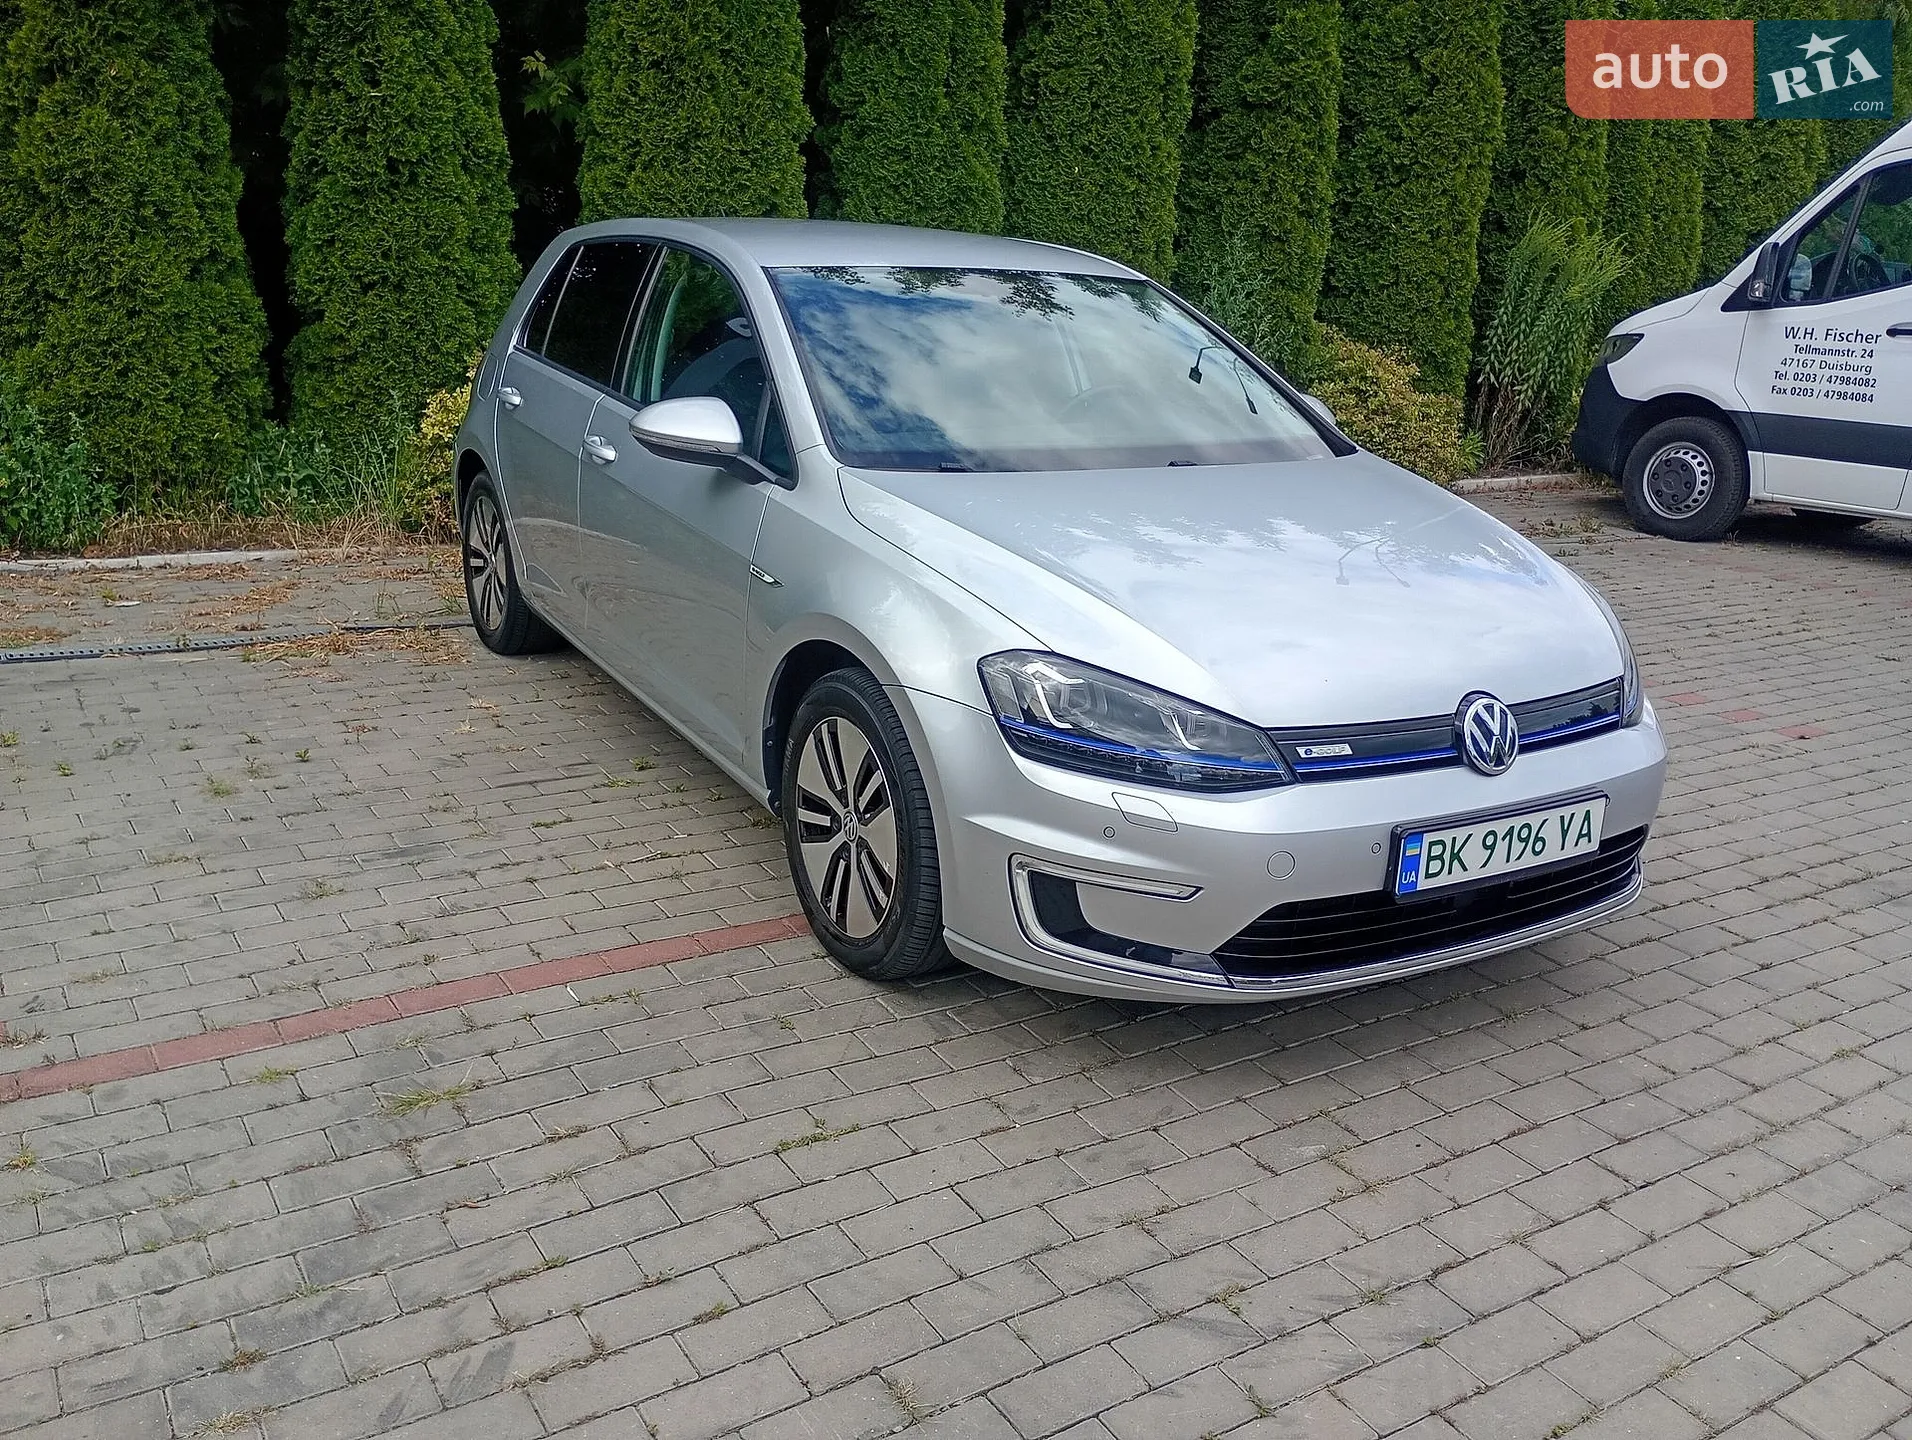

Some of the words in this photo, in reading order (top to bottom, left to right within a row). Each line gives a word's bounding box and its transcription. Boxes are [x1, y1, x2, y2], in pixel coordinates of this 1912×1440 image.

[1785, 326, 1818, 340] W.H.
[1824, 328, 1882, 344] Fischer
[1794, 344, 1857, 358] Tellmannstr.
[1860, 348, 1874, 359] 24
[1780, 357, 1815, 369] 47167
[1819, 360, 1872, 375] Duisburg
[1774, 371, 1790, 381] Tel.
[1793, 372, 1817, 383] 0203
[1826, 375, 1877, 388] 47984082
[1771, 385, 1788, 395] Fax
[1790, 387, 1814, 398] 0203
[1823, 390, 1874, 403] 47984084
[1424, 833, 1473, 879] BK
[1479, 818, 1549, 869] 9196
[1559, 809, 1592, 851] YA
[1402, 871, 1416, 883] UA
